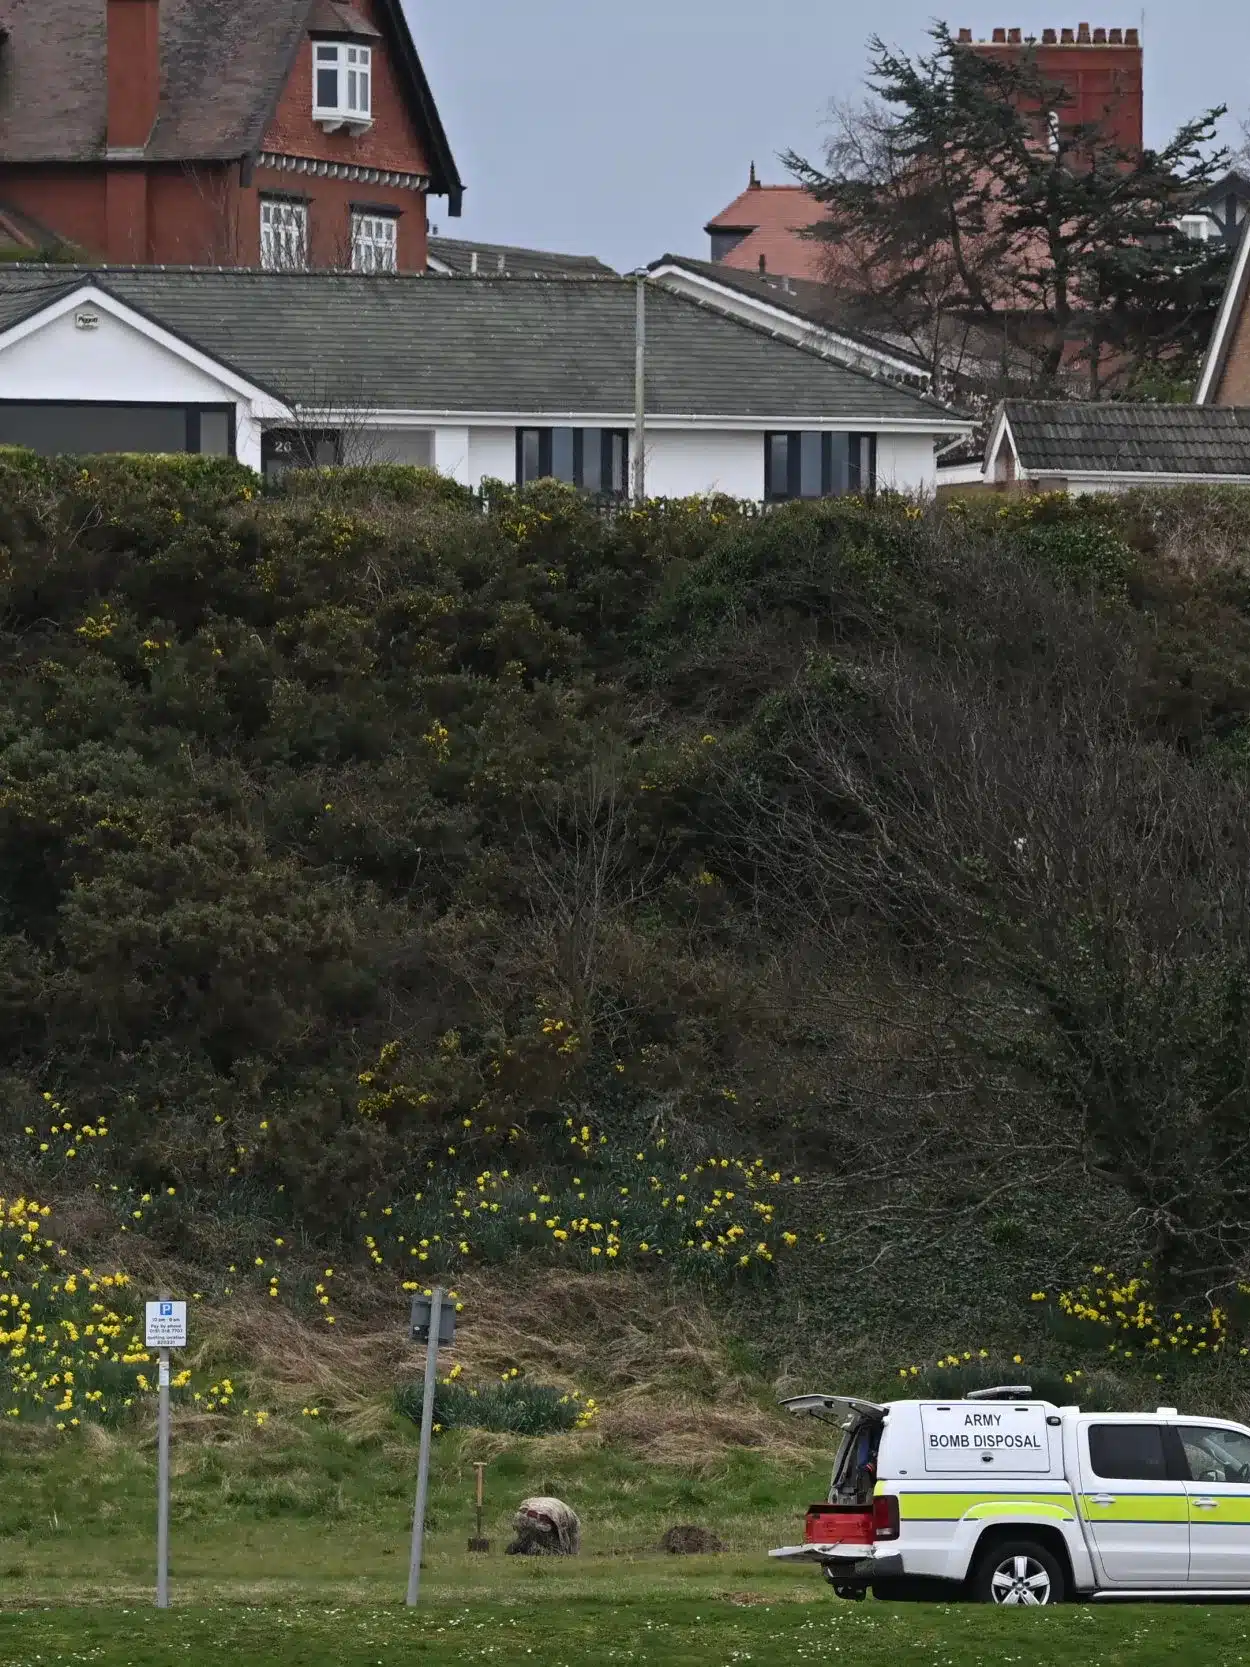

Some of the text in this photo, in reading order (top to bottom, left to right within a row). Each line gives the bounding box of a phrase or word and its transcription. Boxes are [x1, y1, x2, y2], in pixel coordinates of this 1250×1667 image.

[964, 1414, 1002, 1426] ARMY
[930, 1434, 1041, 1448] BOMB DISPOSAL
